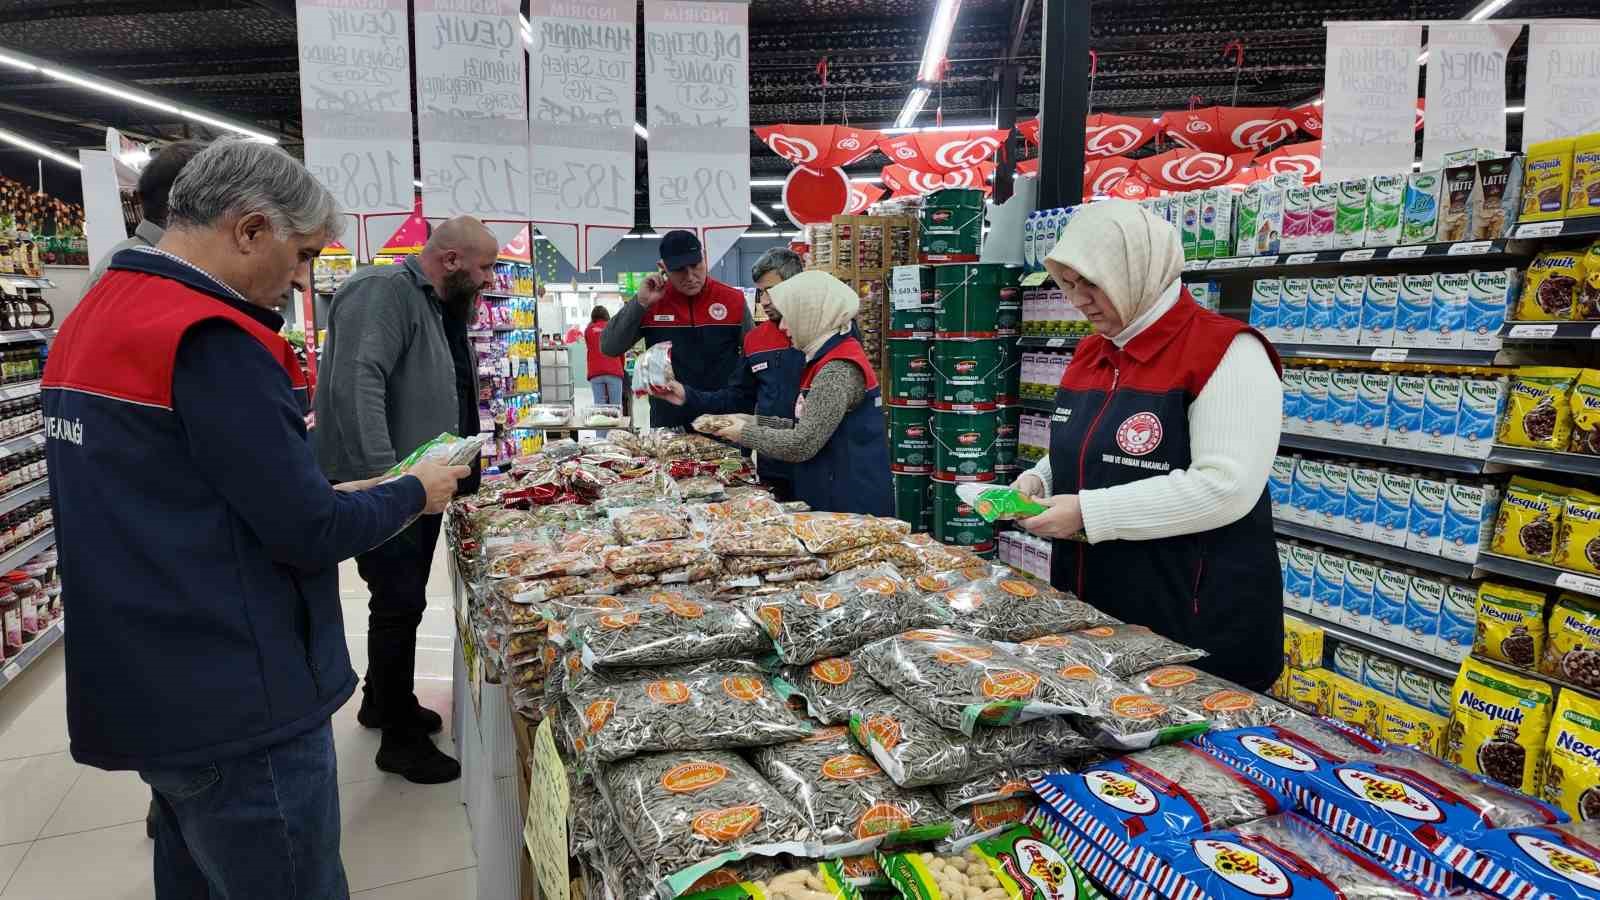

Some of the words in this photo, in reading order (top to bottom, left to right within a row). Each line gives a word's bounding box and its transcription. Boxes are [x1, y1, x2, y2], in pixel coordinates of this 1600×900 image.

[1450, 181, 1474, 192] LATTE
[1483, 174, 1508, 186] LATTE
[1504, 491, 1549, 512] Nesquik
[1480, 603, 1524, 623] Nesquik
[1459, 690, 1524, 725] Nesquik
[1385, 713, 1416, 731] Nesquik
